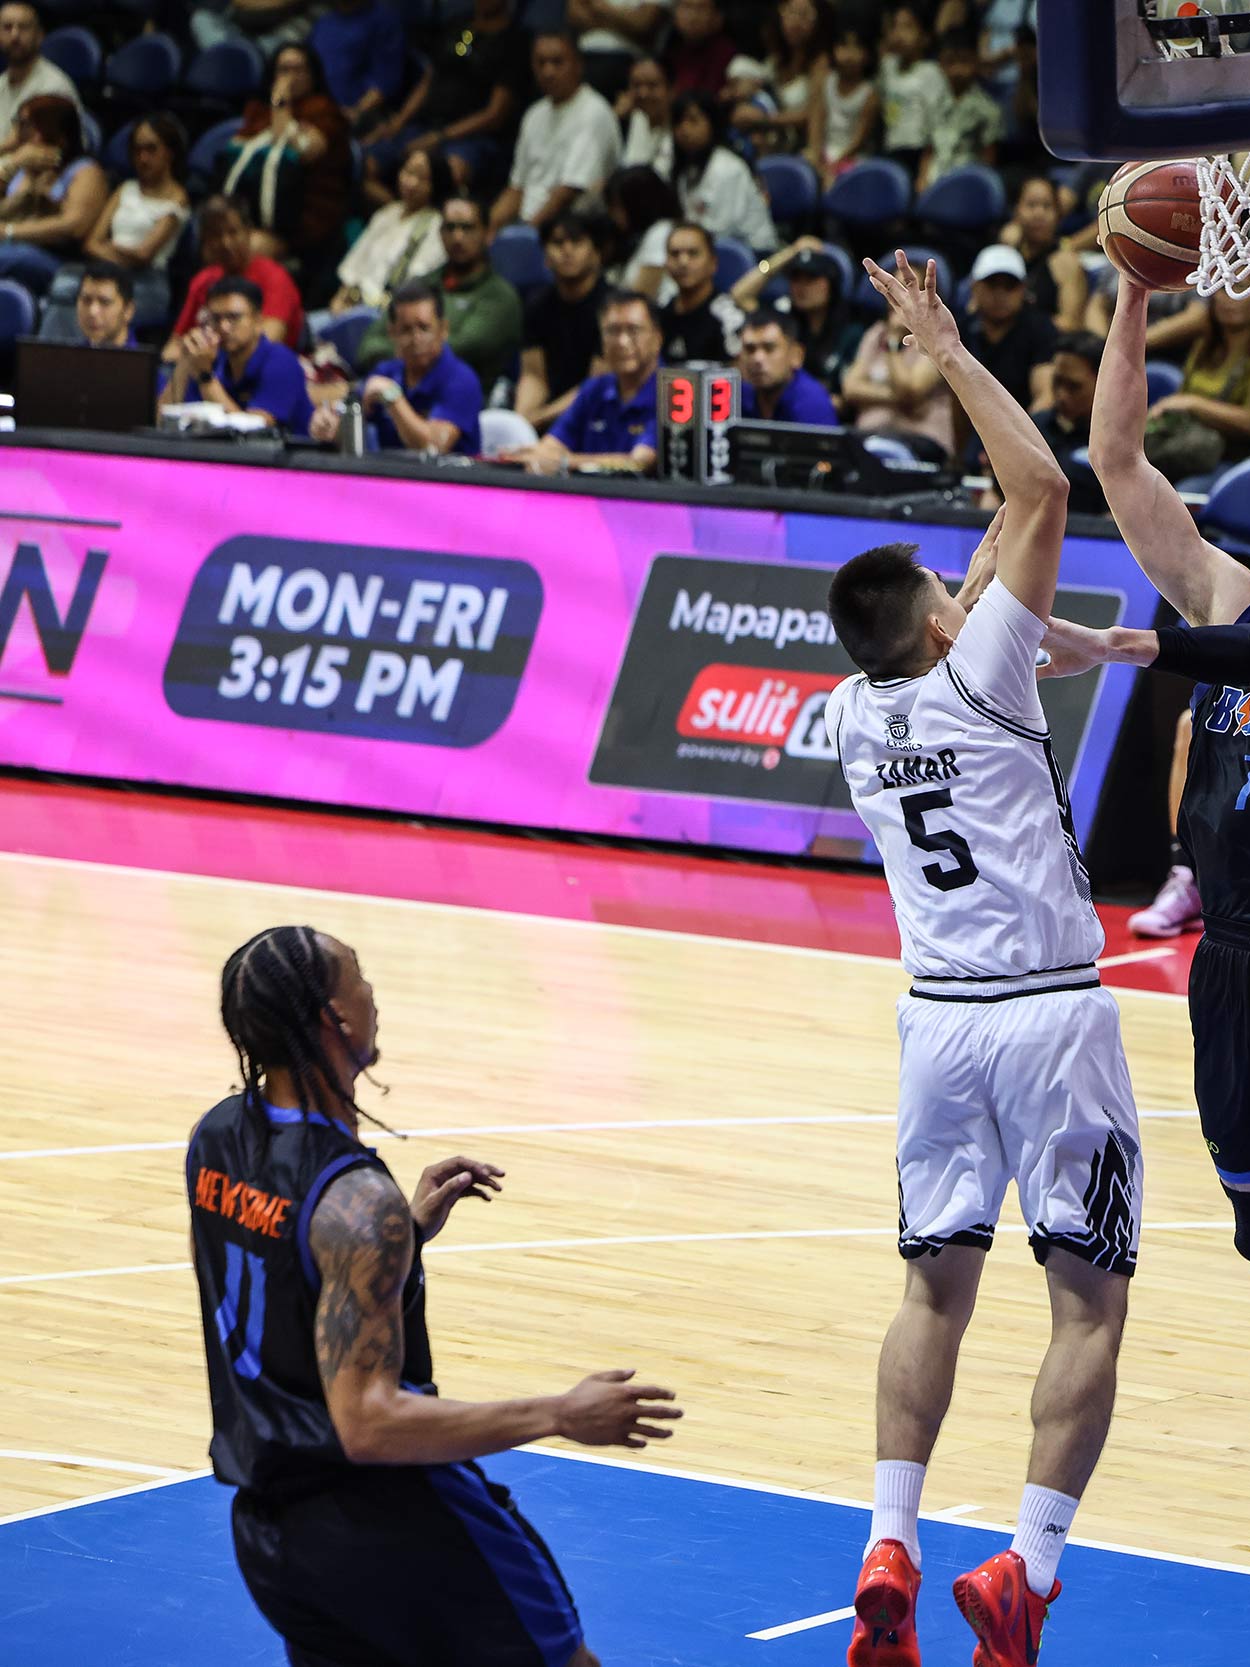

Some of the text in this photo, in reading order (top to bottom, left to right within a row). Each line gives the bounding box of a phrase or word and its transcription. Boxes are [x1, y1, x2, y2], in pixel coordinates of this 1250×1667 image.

[670, 377, 694, 424] 3
[710, 377, 732, 423] 3
[218, 563, 508, 652] MON-FRI
[218, 635, 463, 722] 3:15 PM
[691, 678, 799, 737] sulit
[677, 743, 742, 763] powered
[875, 748, 961, 789] ZAMAR
[899, 788, 979, 890] 5
[195, 1166, 293, 1239] NEWSOME
